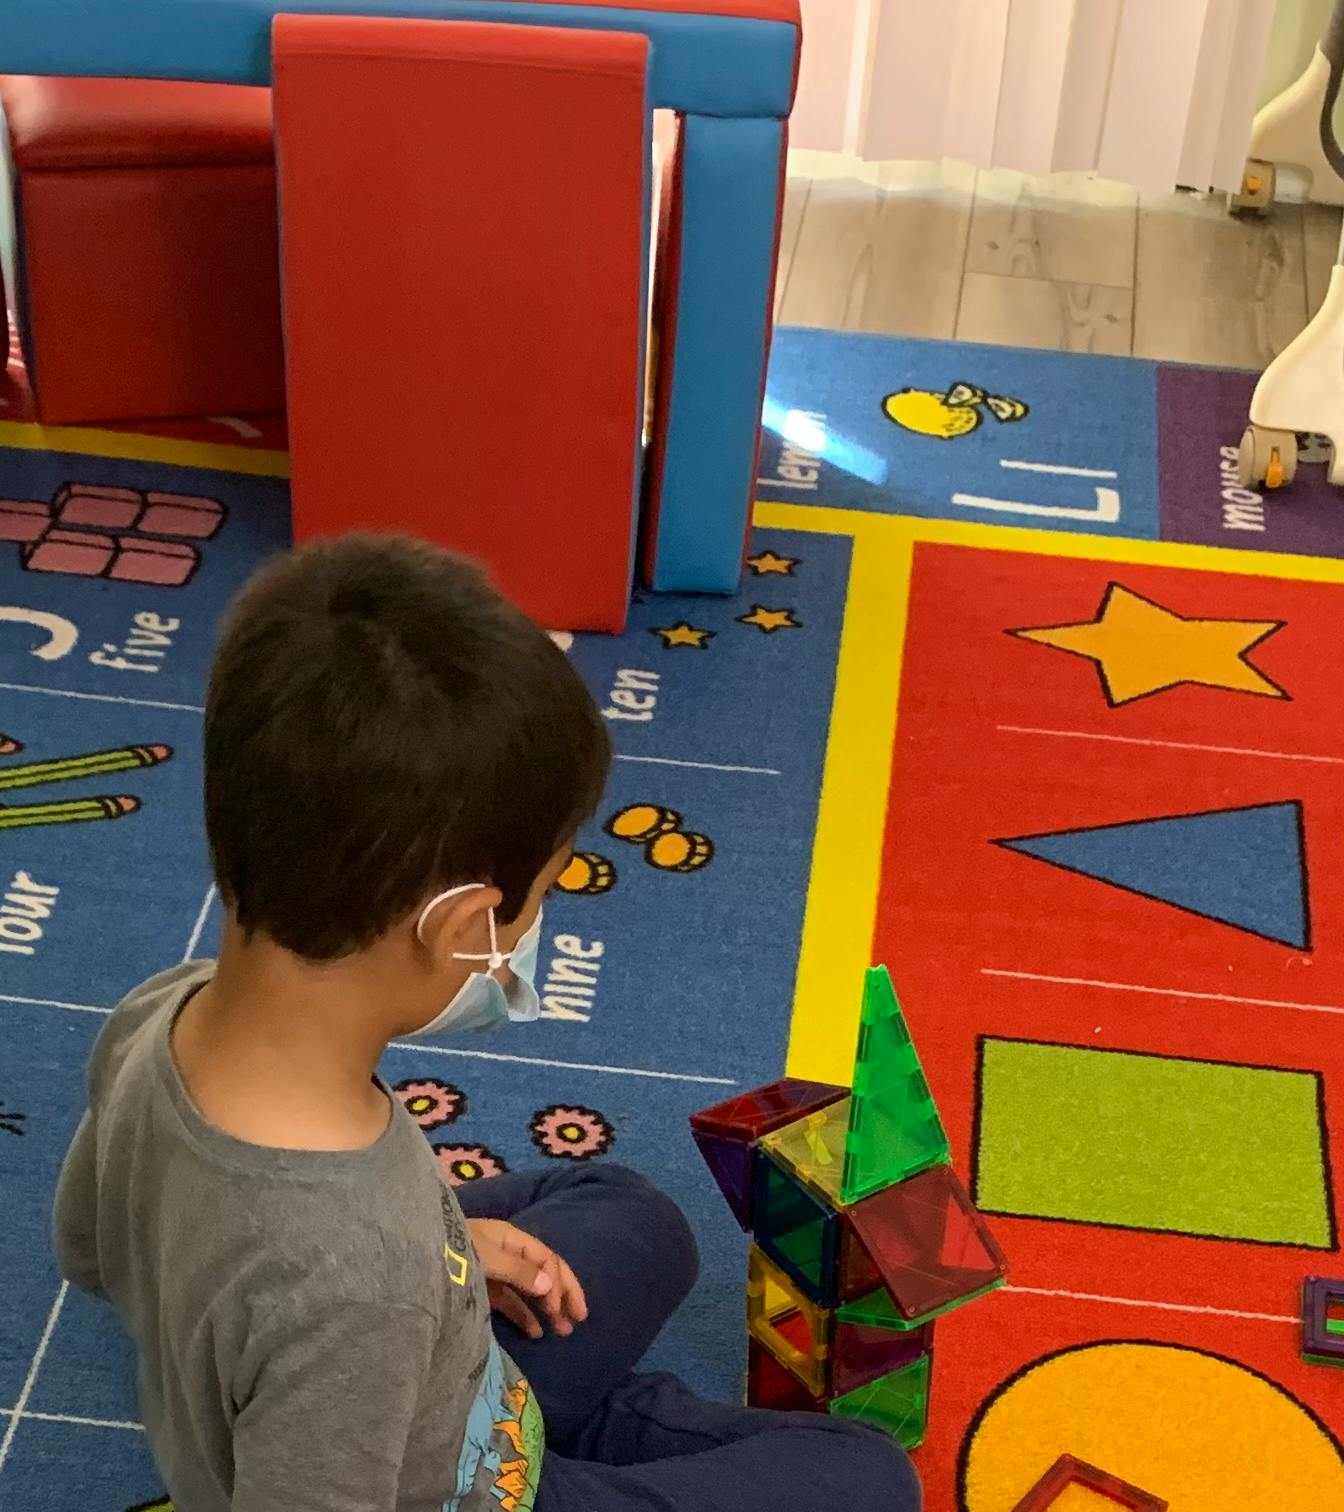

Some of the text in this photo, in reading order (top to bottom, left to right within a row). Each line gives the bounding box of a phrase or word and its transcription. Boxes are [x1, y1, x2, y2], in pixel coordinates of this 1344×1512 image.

[952, 460, 1120, 522] Ll
[89, 612, 179, 672] five
[601, 669, 659, 721] ten
[540, 934, 604, 1022] nine
